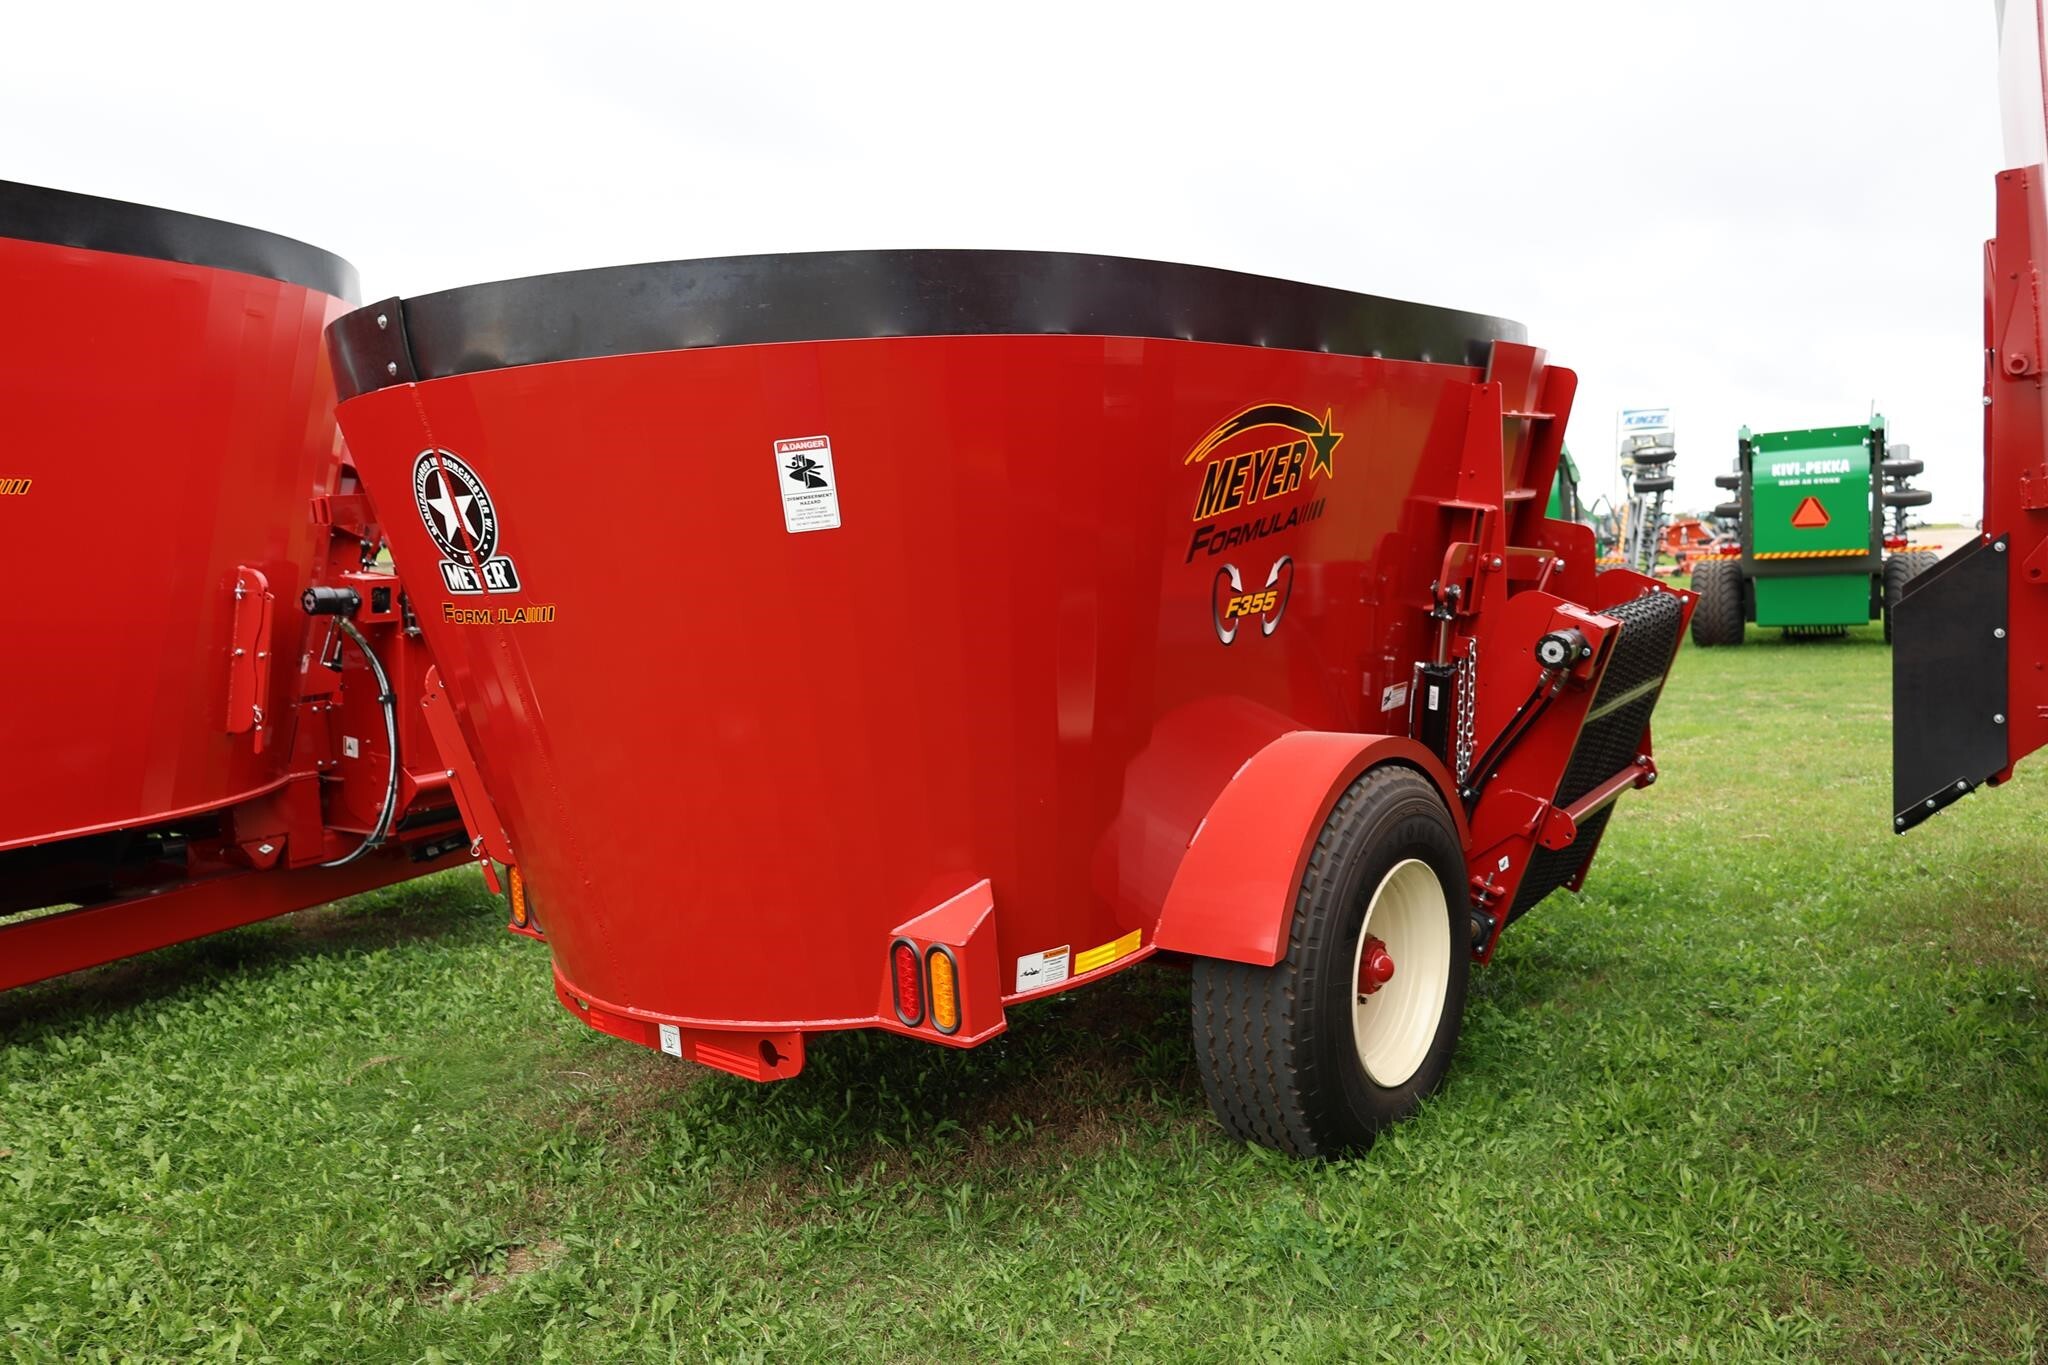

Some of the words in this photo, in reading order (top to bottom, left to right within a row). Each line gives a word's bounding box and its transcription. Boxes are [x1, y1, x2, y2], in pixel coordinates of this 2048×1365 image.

[1624, 415, 1665, 425] KINZE
[789, 440, 825, 451] DANGER
[1193, 439, 1309, 521] MEYER
[1771, 458, 1850, 477] KIVI-PEKKA
[441, 457, 490, 514] DORCHESTER
[1185, 508, 1299, 564] FORMULA
[443, 561, 511, 590] MEYER
[1225, 590, 1278, 618] F355
